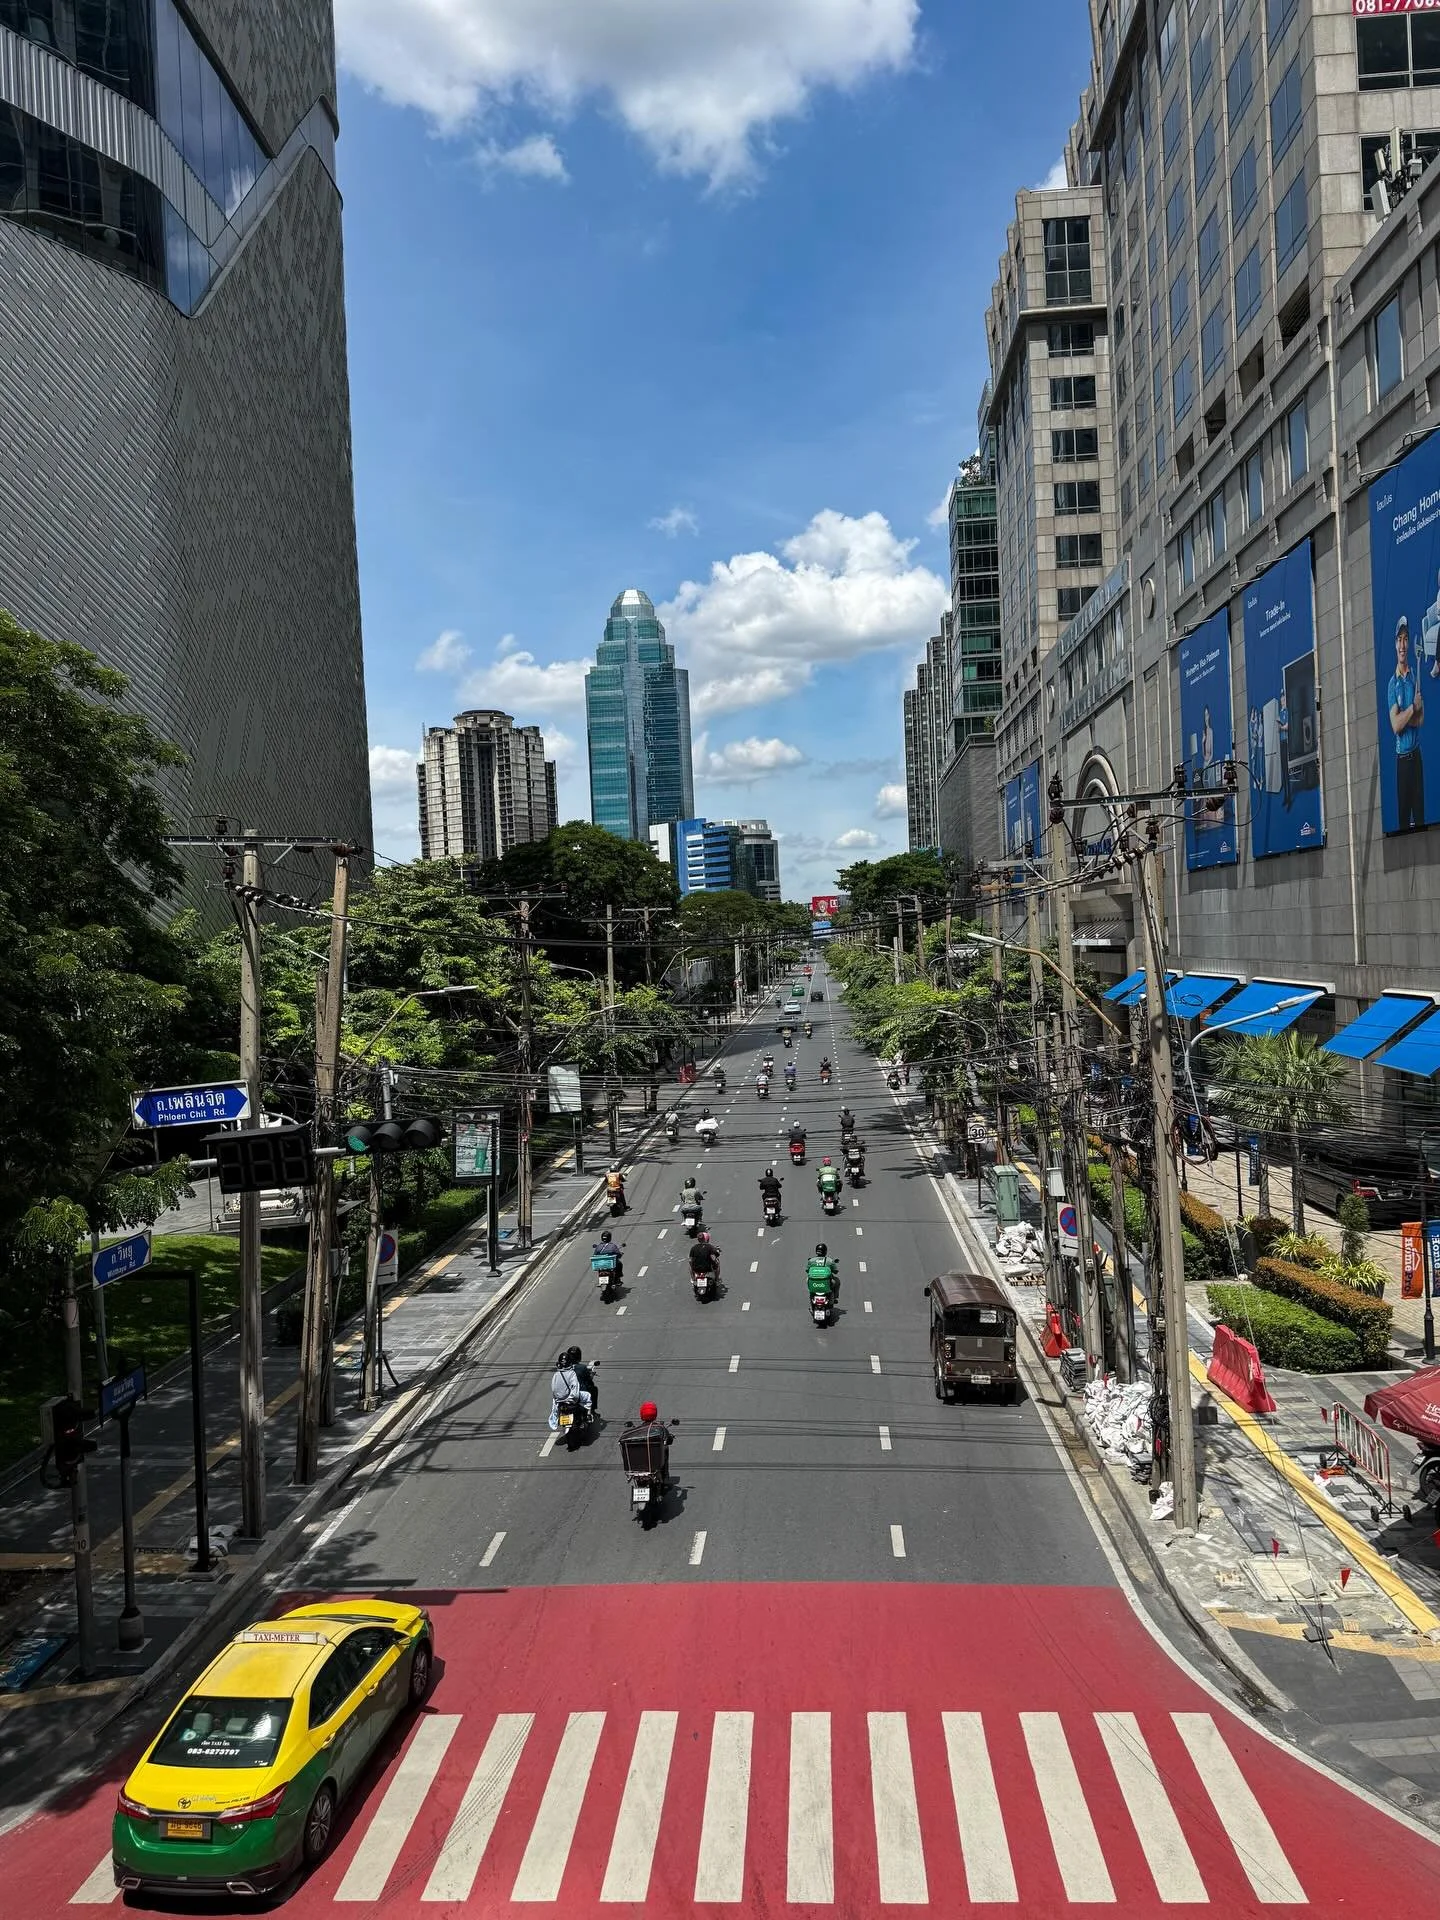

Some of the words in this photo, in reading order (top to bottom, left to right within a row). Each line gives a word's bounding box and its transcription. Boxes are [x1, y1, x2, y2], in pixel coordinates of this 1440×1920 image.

[1393, 506, 1417, 532] Chang
[1419, 489, 1440, 513] Hom
[156, 1089, 226, 1112] ถ.เพลินจิต
[158, 1112, 187, 1122] Phloen
[189, 1110, 207, 1119] Chit
[971, 1128, 985, 1138] 30
[1405, 1237, 1414, 1293] HomePro
[254, 1633, 300, 1642] TAXI-METER
